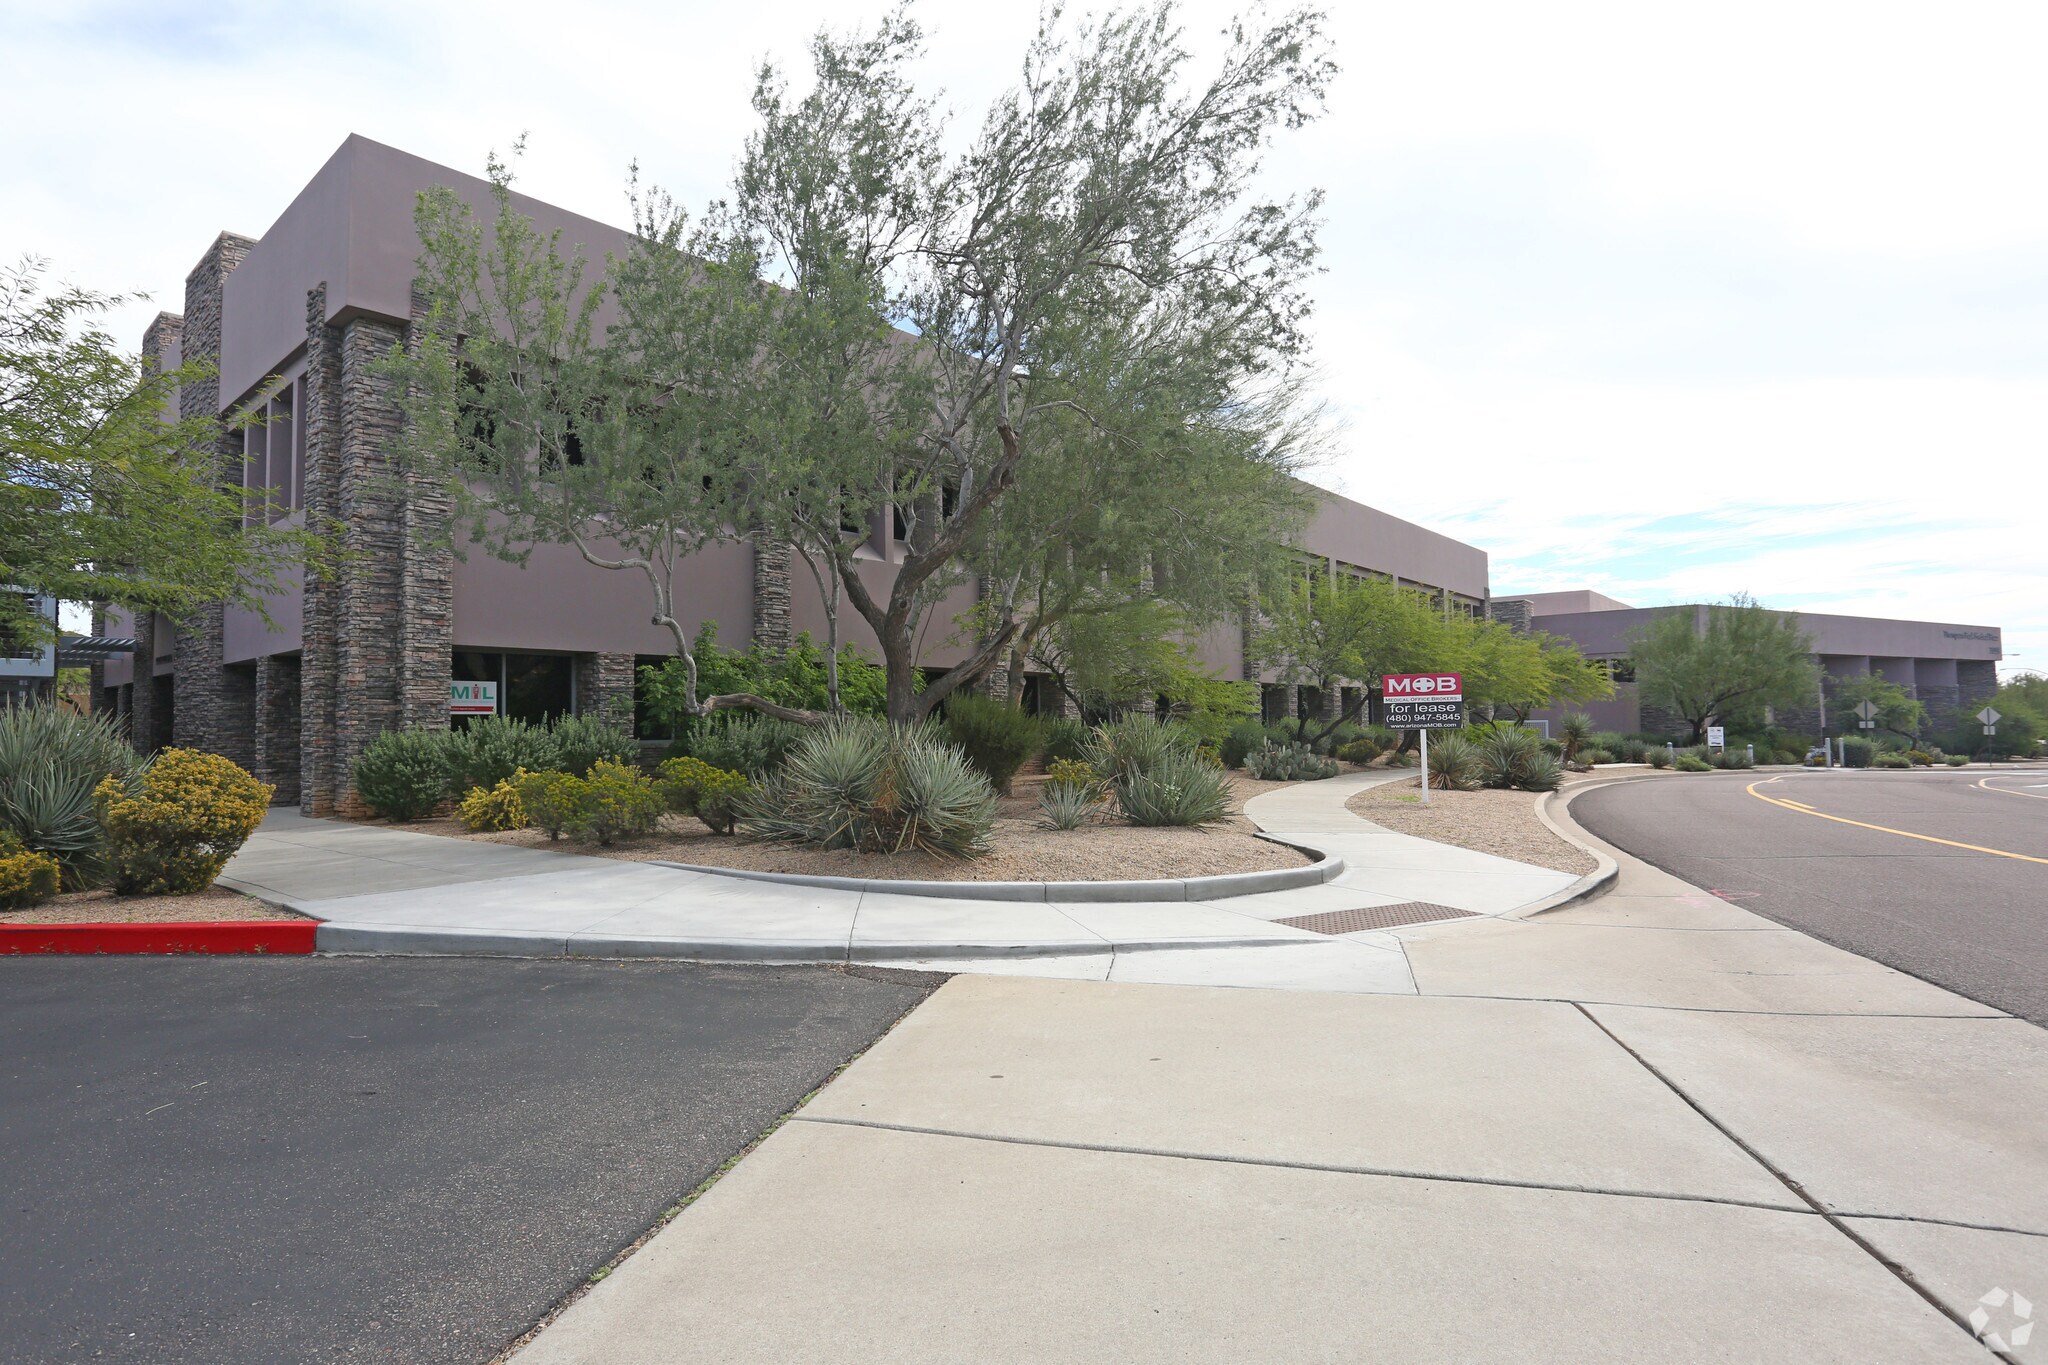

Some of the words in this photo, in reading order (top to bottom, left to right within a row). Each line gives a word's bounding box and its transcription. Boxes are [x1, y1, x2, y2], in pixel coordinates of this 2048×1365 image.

[1388, 676, 1457, 693] MOB
[1390, 703, 1411, 713] for
[1415, 703, 1456, 713] lease
[1386, 714, 1411, 723] (480)
[1413, 713, 1461, 721] 947-5845
